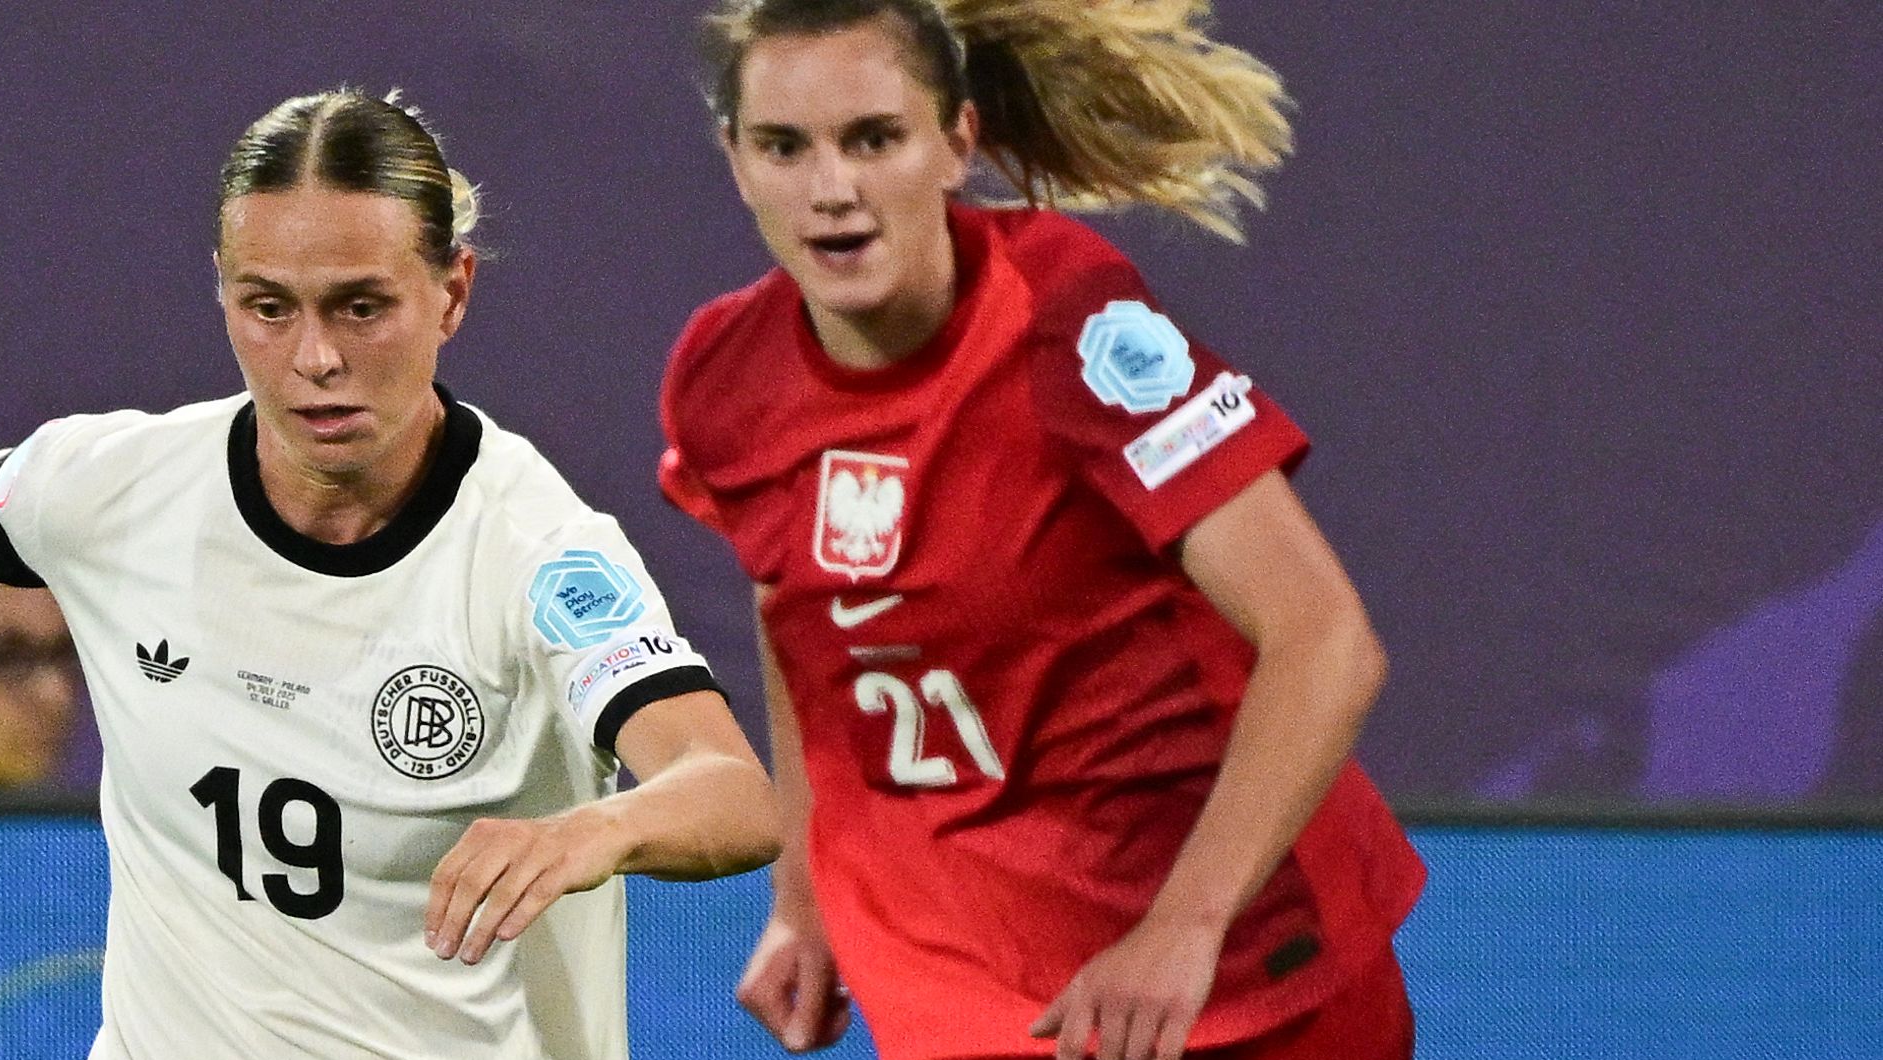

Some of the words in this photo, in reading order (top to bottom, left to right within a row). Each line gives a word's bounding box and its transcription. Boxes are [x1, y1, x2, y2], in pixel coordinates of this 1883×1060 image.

[556, 586, 577, 598] We
[565, 590, 595, 610] Play
[573, 592, 616, 618] Strong
[237, 670, 273, 684] GERMANY
[282, 680, 311, 694] POLAND
[377, 674, 413, 760] DEUTSCHER
[854, 670, 1006, 786] 21
[411, 761, 434, 774] 125
[189, 766, 345, 920] 19
